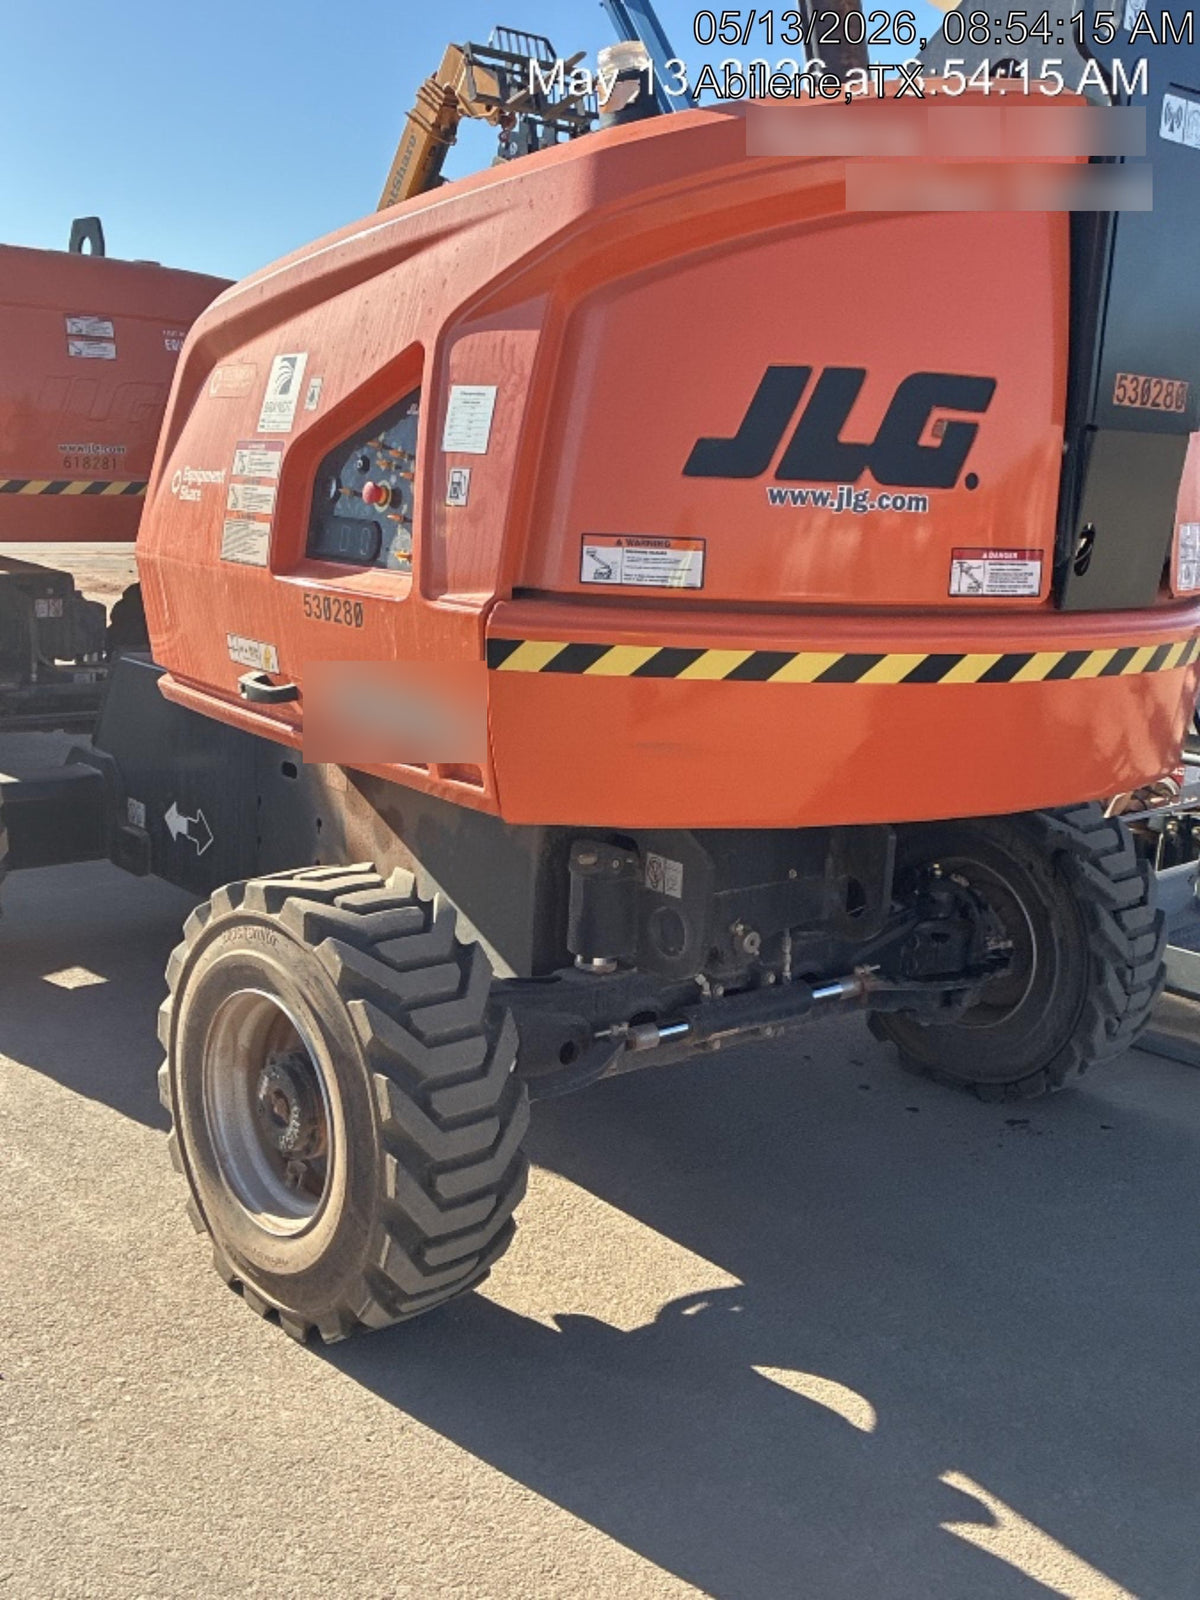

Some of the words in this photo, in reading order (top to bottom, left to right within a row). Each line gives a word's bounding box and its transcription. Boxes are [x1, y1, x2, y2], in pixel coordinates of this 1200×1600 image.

[1115, 374, 1188, 411] 530280
[63, 455, 117, 470] 618281
[767, 486, 929, 513] www.jlg.com
[303, 593, 364, 628] 530280
